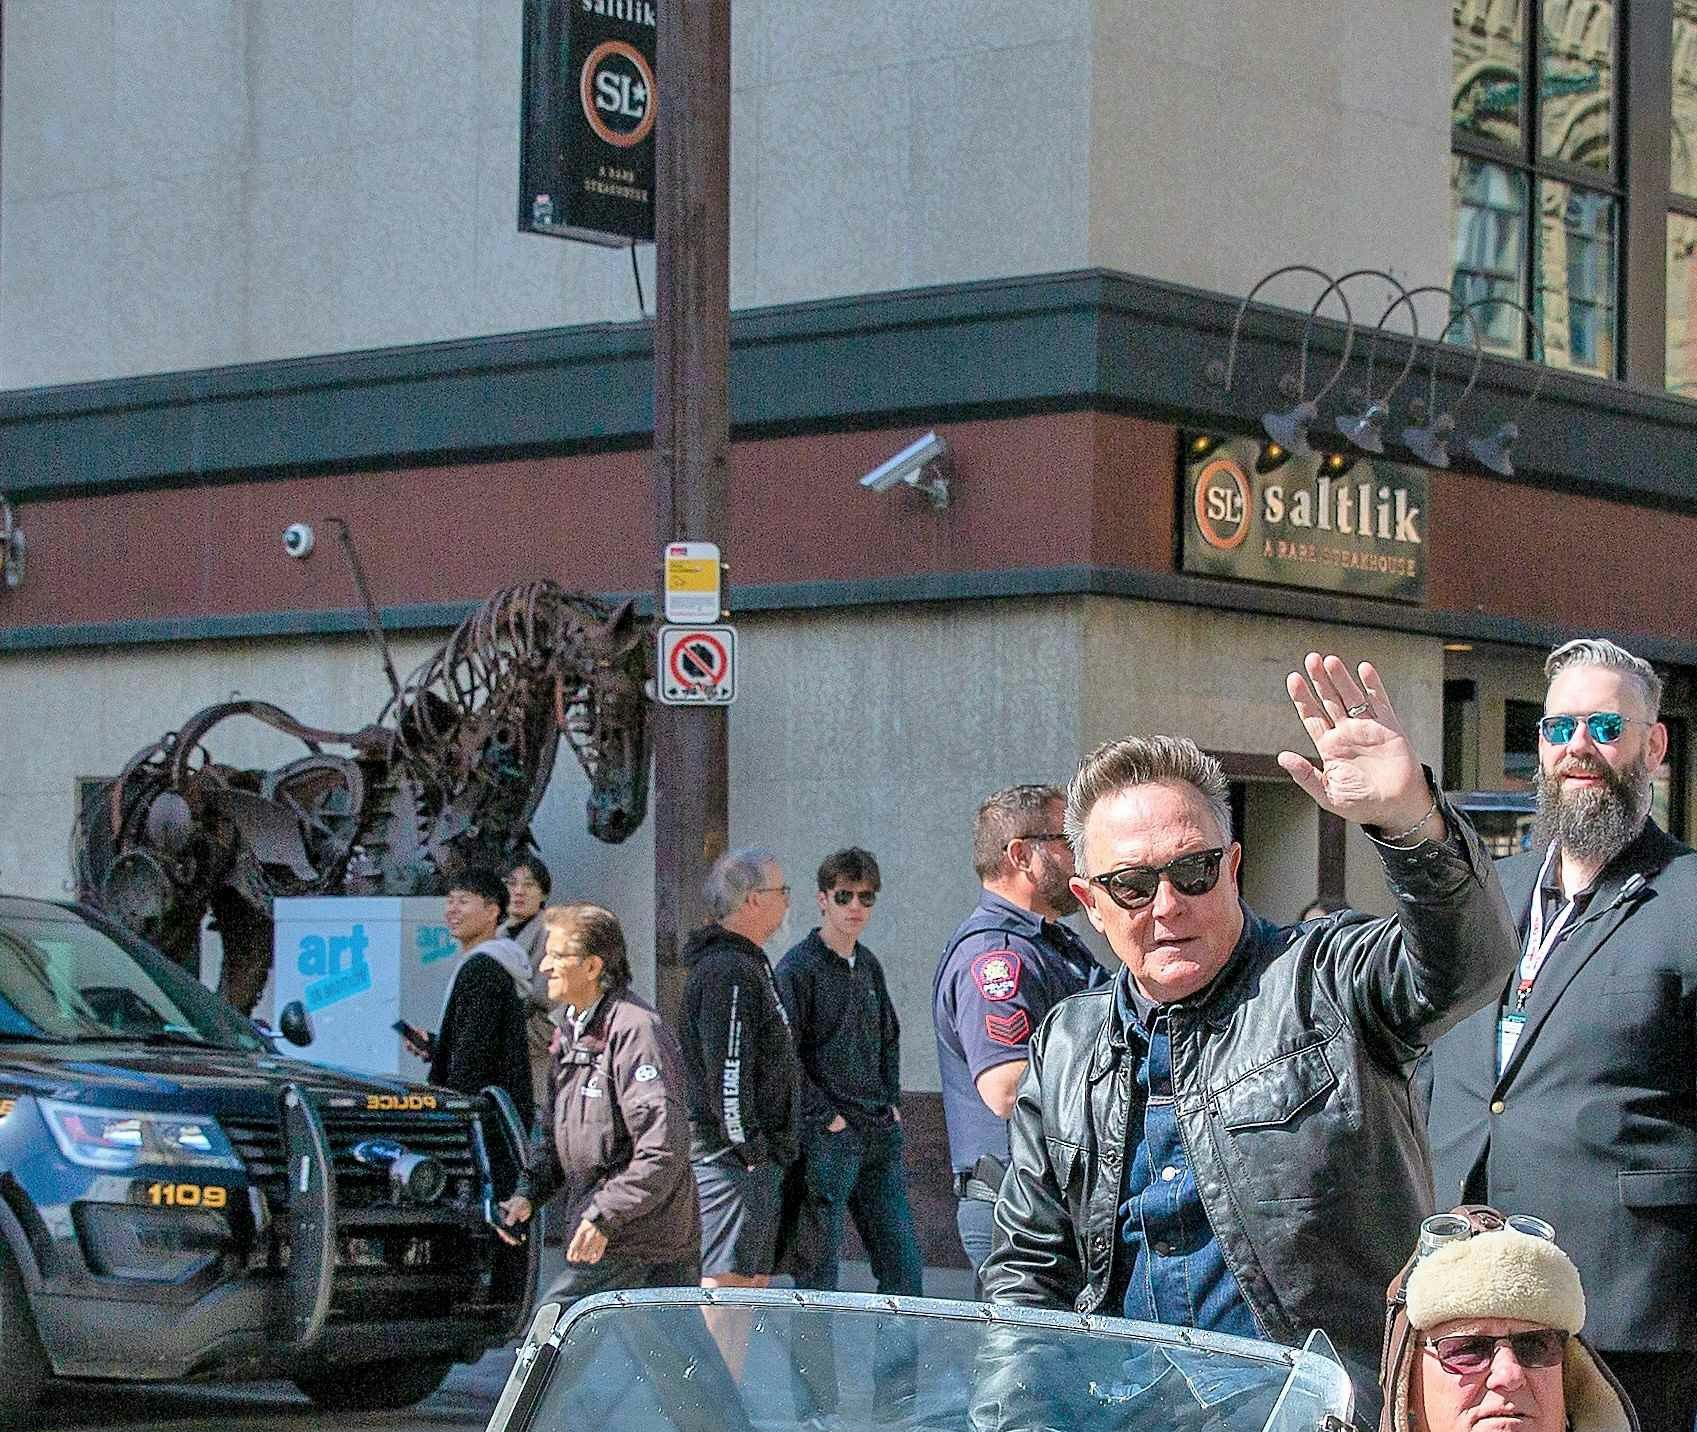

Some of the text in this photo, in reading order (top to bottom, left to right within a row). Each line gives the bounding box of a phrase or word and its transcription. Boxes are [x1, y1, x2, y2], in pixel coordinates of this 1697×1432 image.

[1263, 475, 1422, 544] saltlik
[297, 923, 369, 976] art
[147, 1182, 227, 1209] 1109
